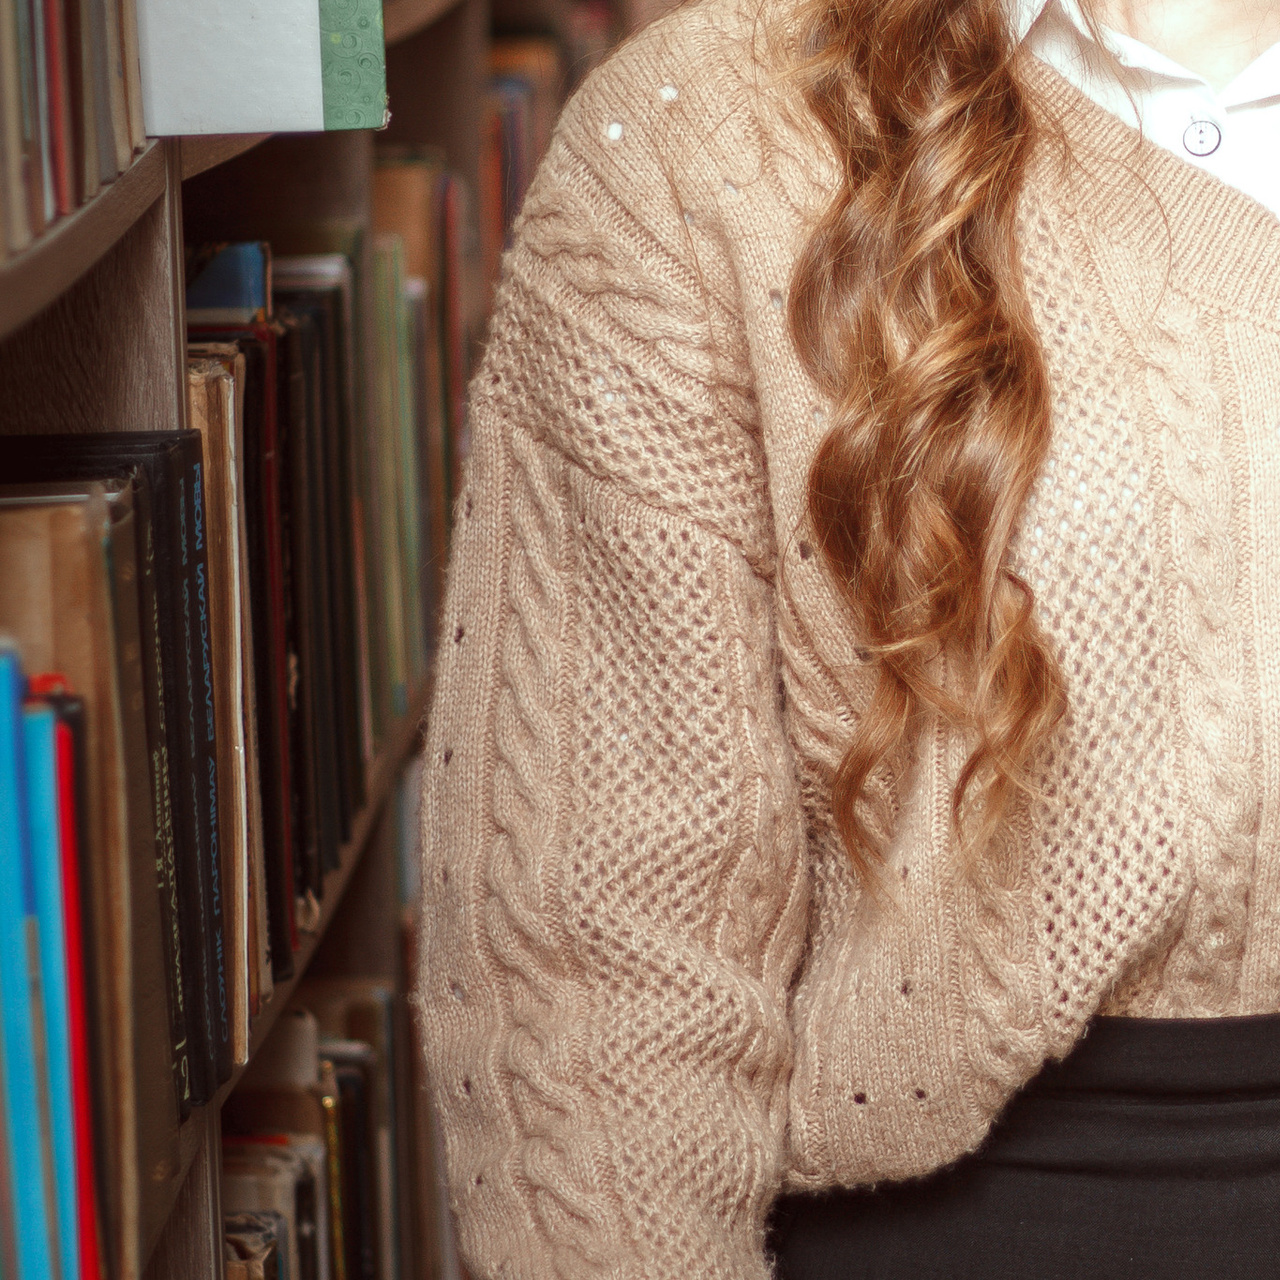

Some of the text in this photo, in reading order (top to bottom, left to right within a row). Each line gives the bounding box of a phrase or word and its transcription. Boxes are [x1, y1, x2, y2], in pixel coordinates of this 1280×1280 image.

[193, 462, 229, 1043] СЛОЎНІК ПАРОНІМАЎ БЕЛАРУСКАЙ МОВЫ
